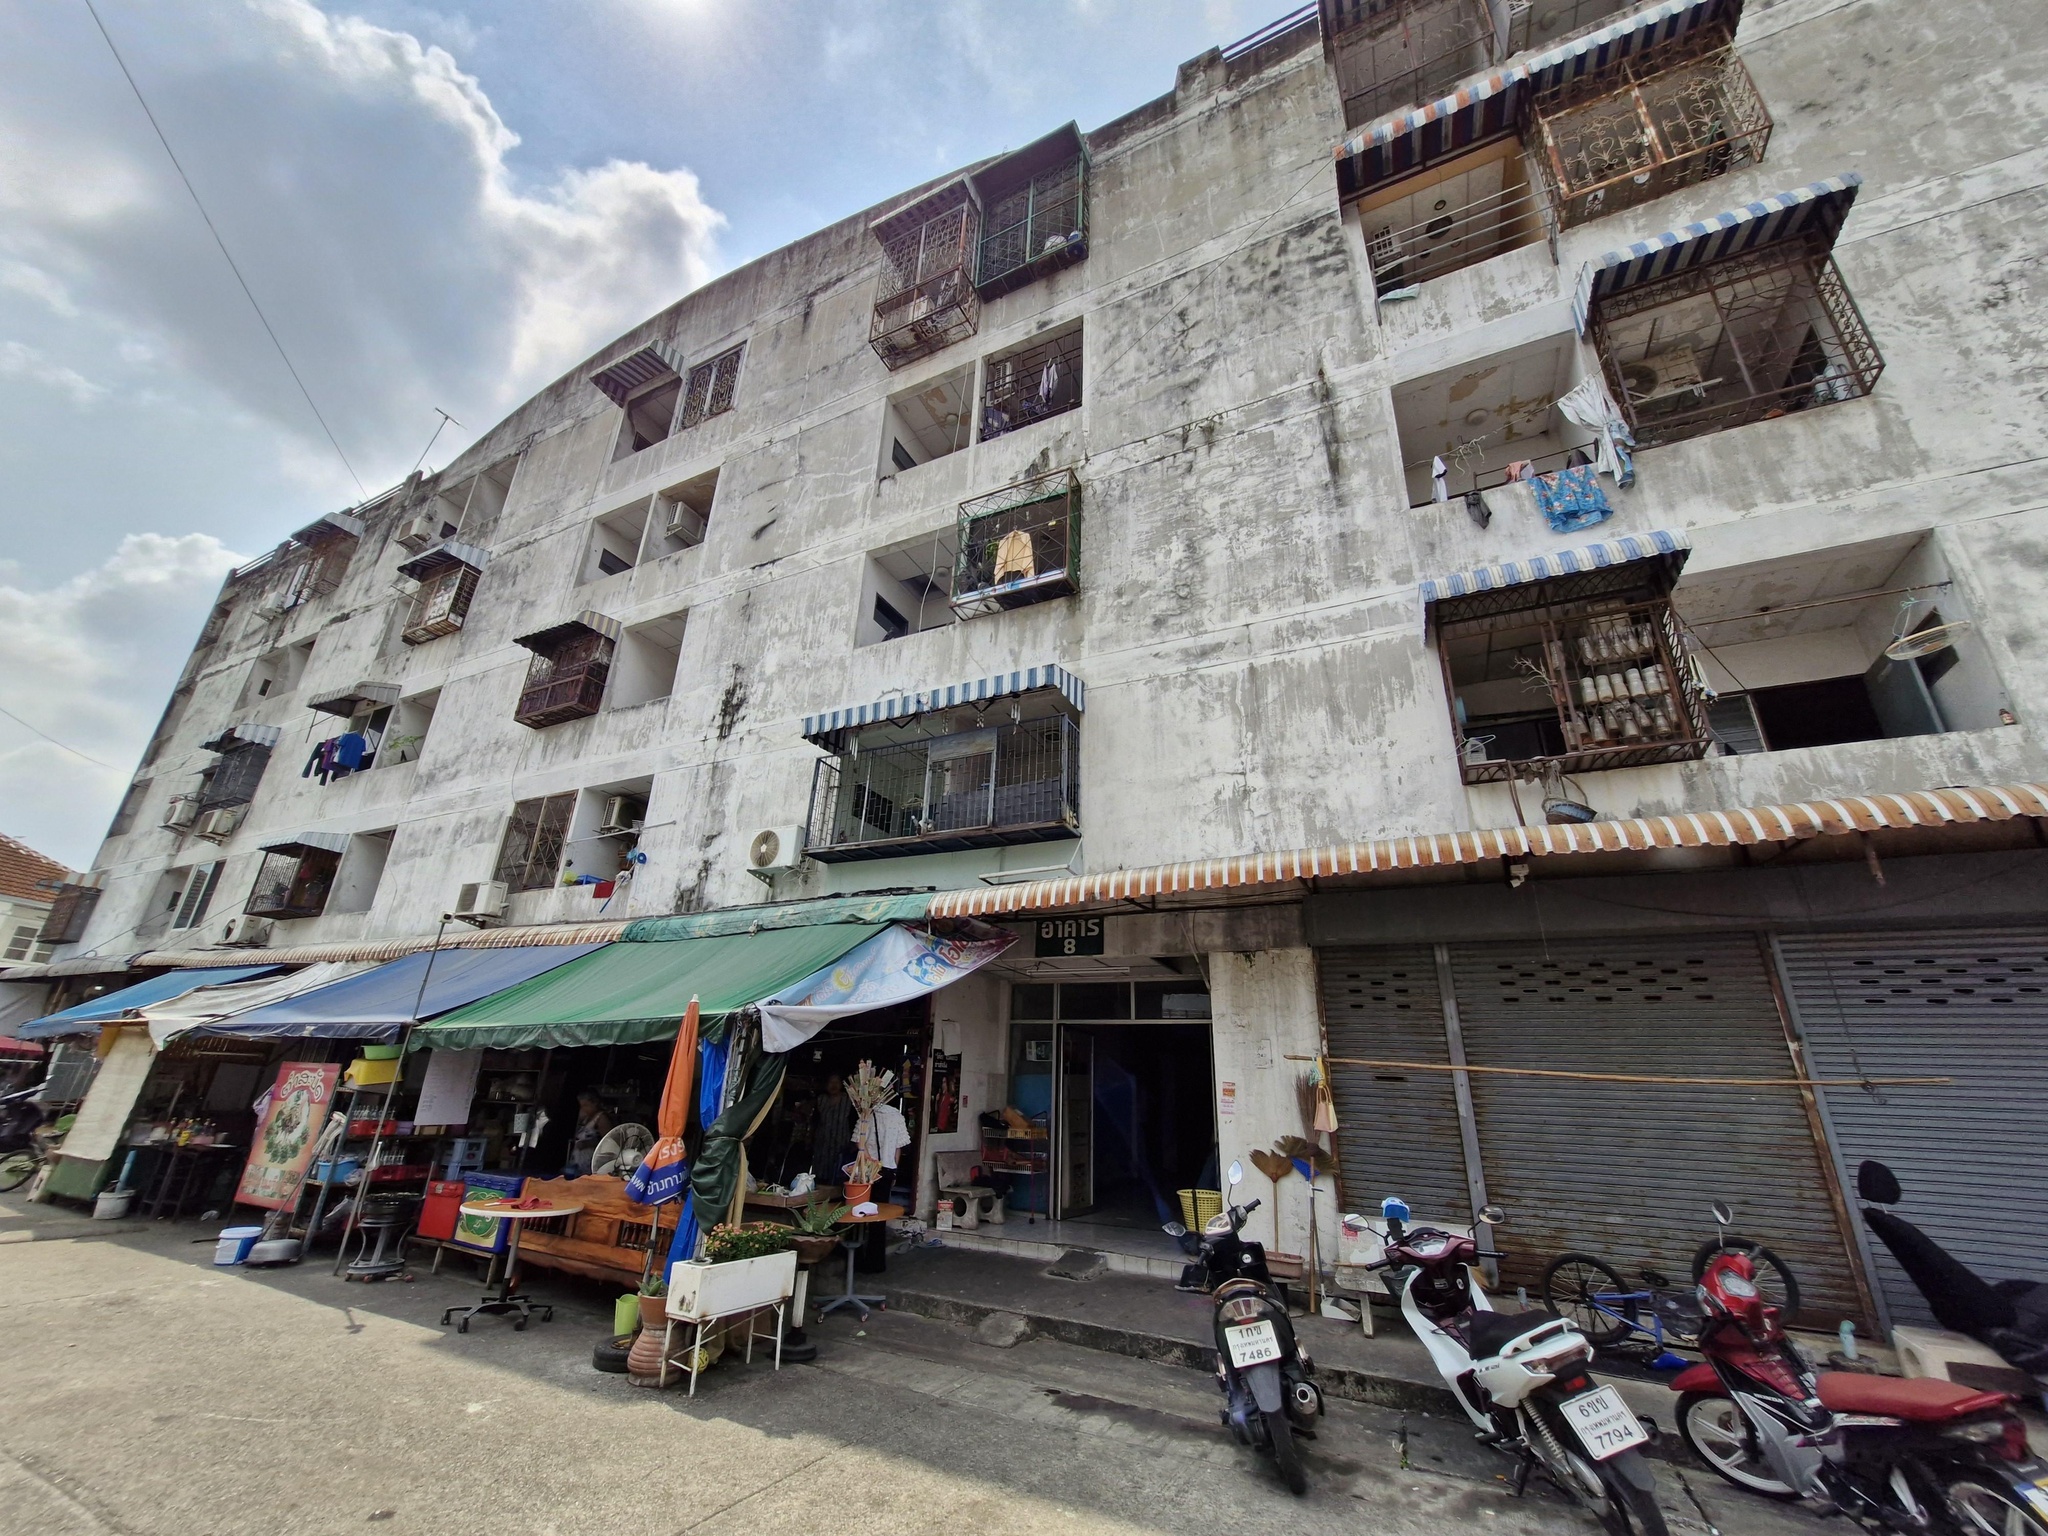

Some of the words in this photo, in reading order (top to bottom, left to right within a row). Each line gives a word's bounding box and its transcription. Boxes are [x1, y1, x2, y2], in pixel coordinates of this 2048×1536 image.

[1041, 918, 1100, 939] อาคาร
[1063, 938, 1076, 954] 8
[1239, 1347, 1272, 1363] 7486
[1594, 1424, 1634, 1450] 7794
